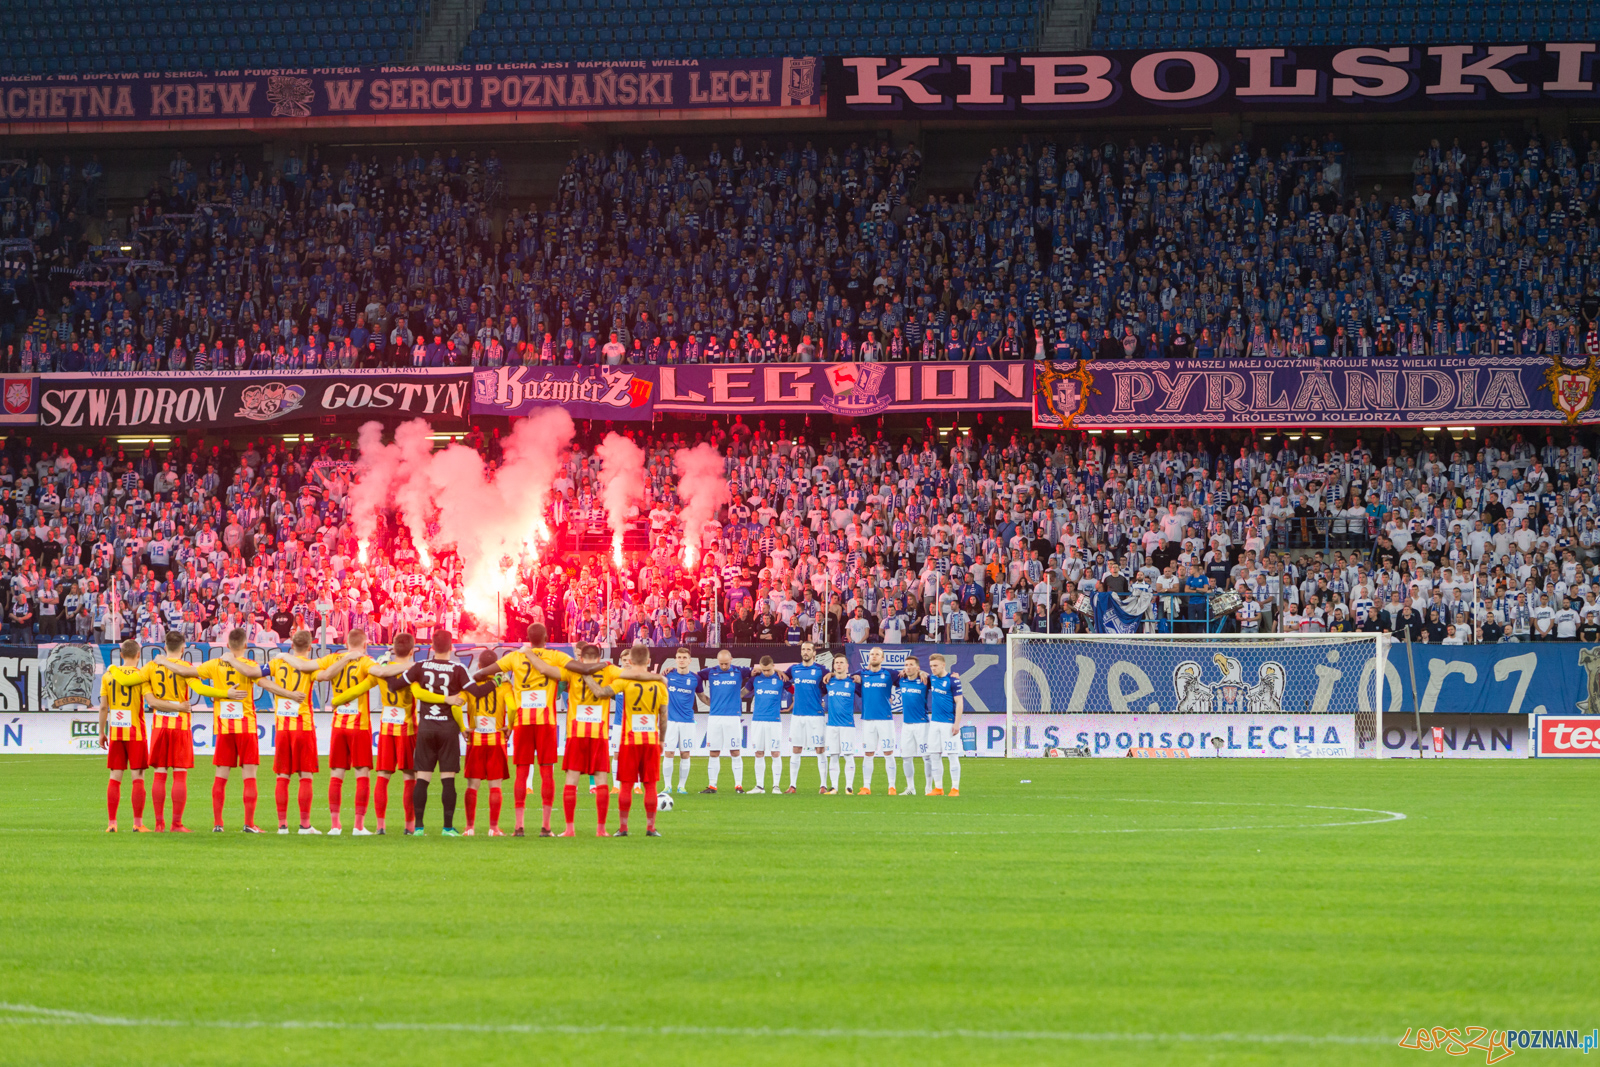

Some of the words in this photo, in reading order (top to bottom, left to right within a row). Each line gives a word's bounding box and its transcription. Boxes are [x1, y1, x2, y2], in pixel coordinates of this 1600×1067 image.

[652, 59, 699, 67] WIELKA
[842, 43, 1596, 104] KIBOLSKI
[150, 82, 257, 115] KREW
[324, 80, 364, 111] W
[369, 77, 473, 110] SERCU
[481, 67, 674, 108] POZNAŃSKI
[689, 70, 772, 103] LECH
[1174, 360, 1185, 369] W
[1188, 360, 1226, 369] NASZEJ
[1229, 359, 1261, 368] MAŁEJ
[1323, 356, 1368, 368] KRÓLUJE
[1371, 359, 1399, 368] NASZ
[1402, 359, 1437, 367] WIELKI
[1440, 358, 1466, 367] LECH
[1112, 367, 1531, 413] PYRLANDIA
[40, 386, 226, 427] SZWADRON
[321, 377, 470, 418] GOSTYŃ
[834, 395, 877, 405] PIŁA
[1232, 411, 1317, 422] KRÓLESTWO
[1322, 411, 1402, 422] KOLEJORZA
[152, 546, 165, 556] 12
[885, 653, 905, 663] LECH
[156, 670, 179, 699] 31
[424, 671, 450, 697] 33
[633, 684, 658, 712] 21
[683, 739, 693, 748] 66
[882, 738, 890, 748] 32
[987, 725, 1060, 750] PILS
[1077, 730, 1212, 754] sponsor
[1227, 725, 1341, 750] LECHA
[841, 741, 849, 751] 22
[944, 741, 952, 751] 29
[1316, 747, 1348, 757] AFORTI
